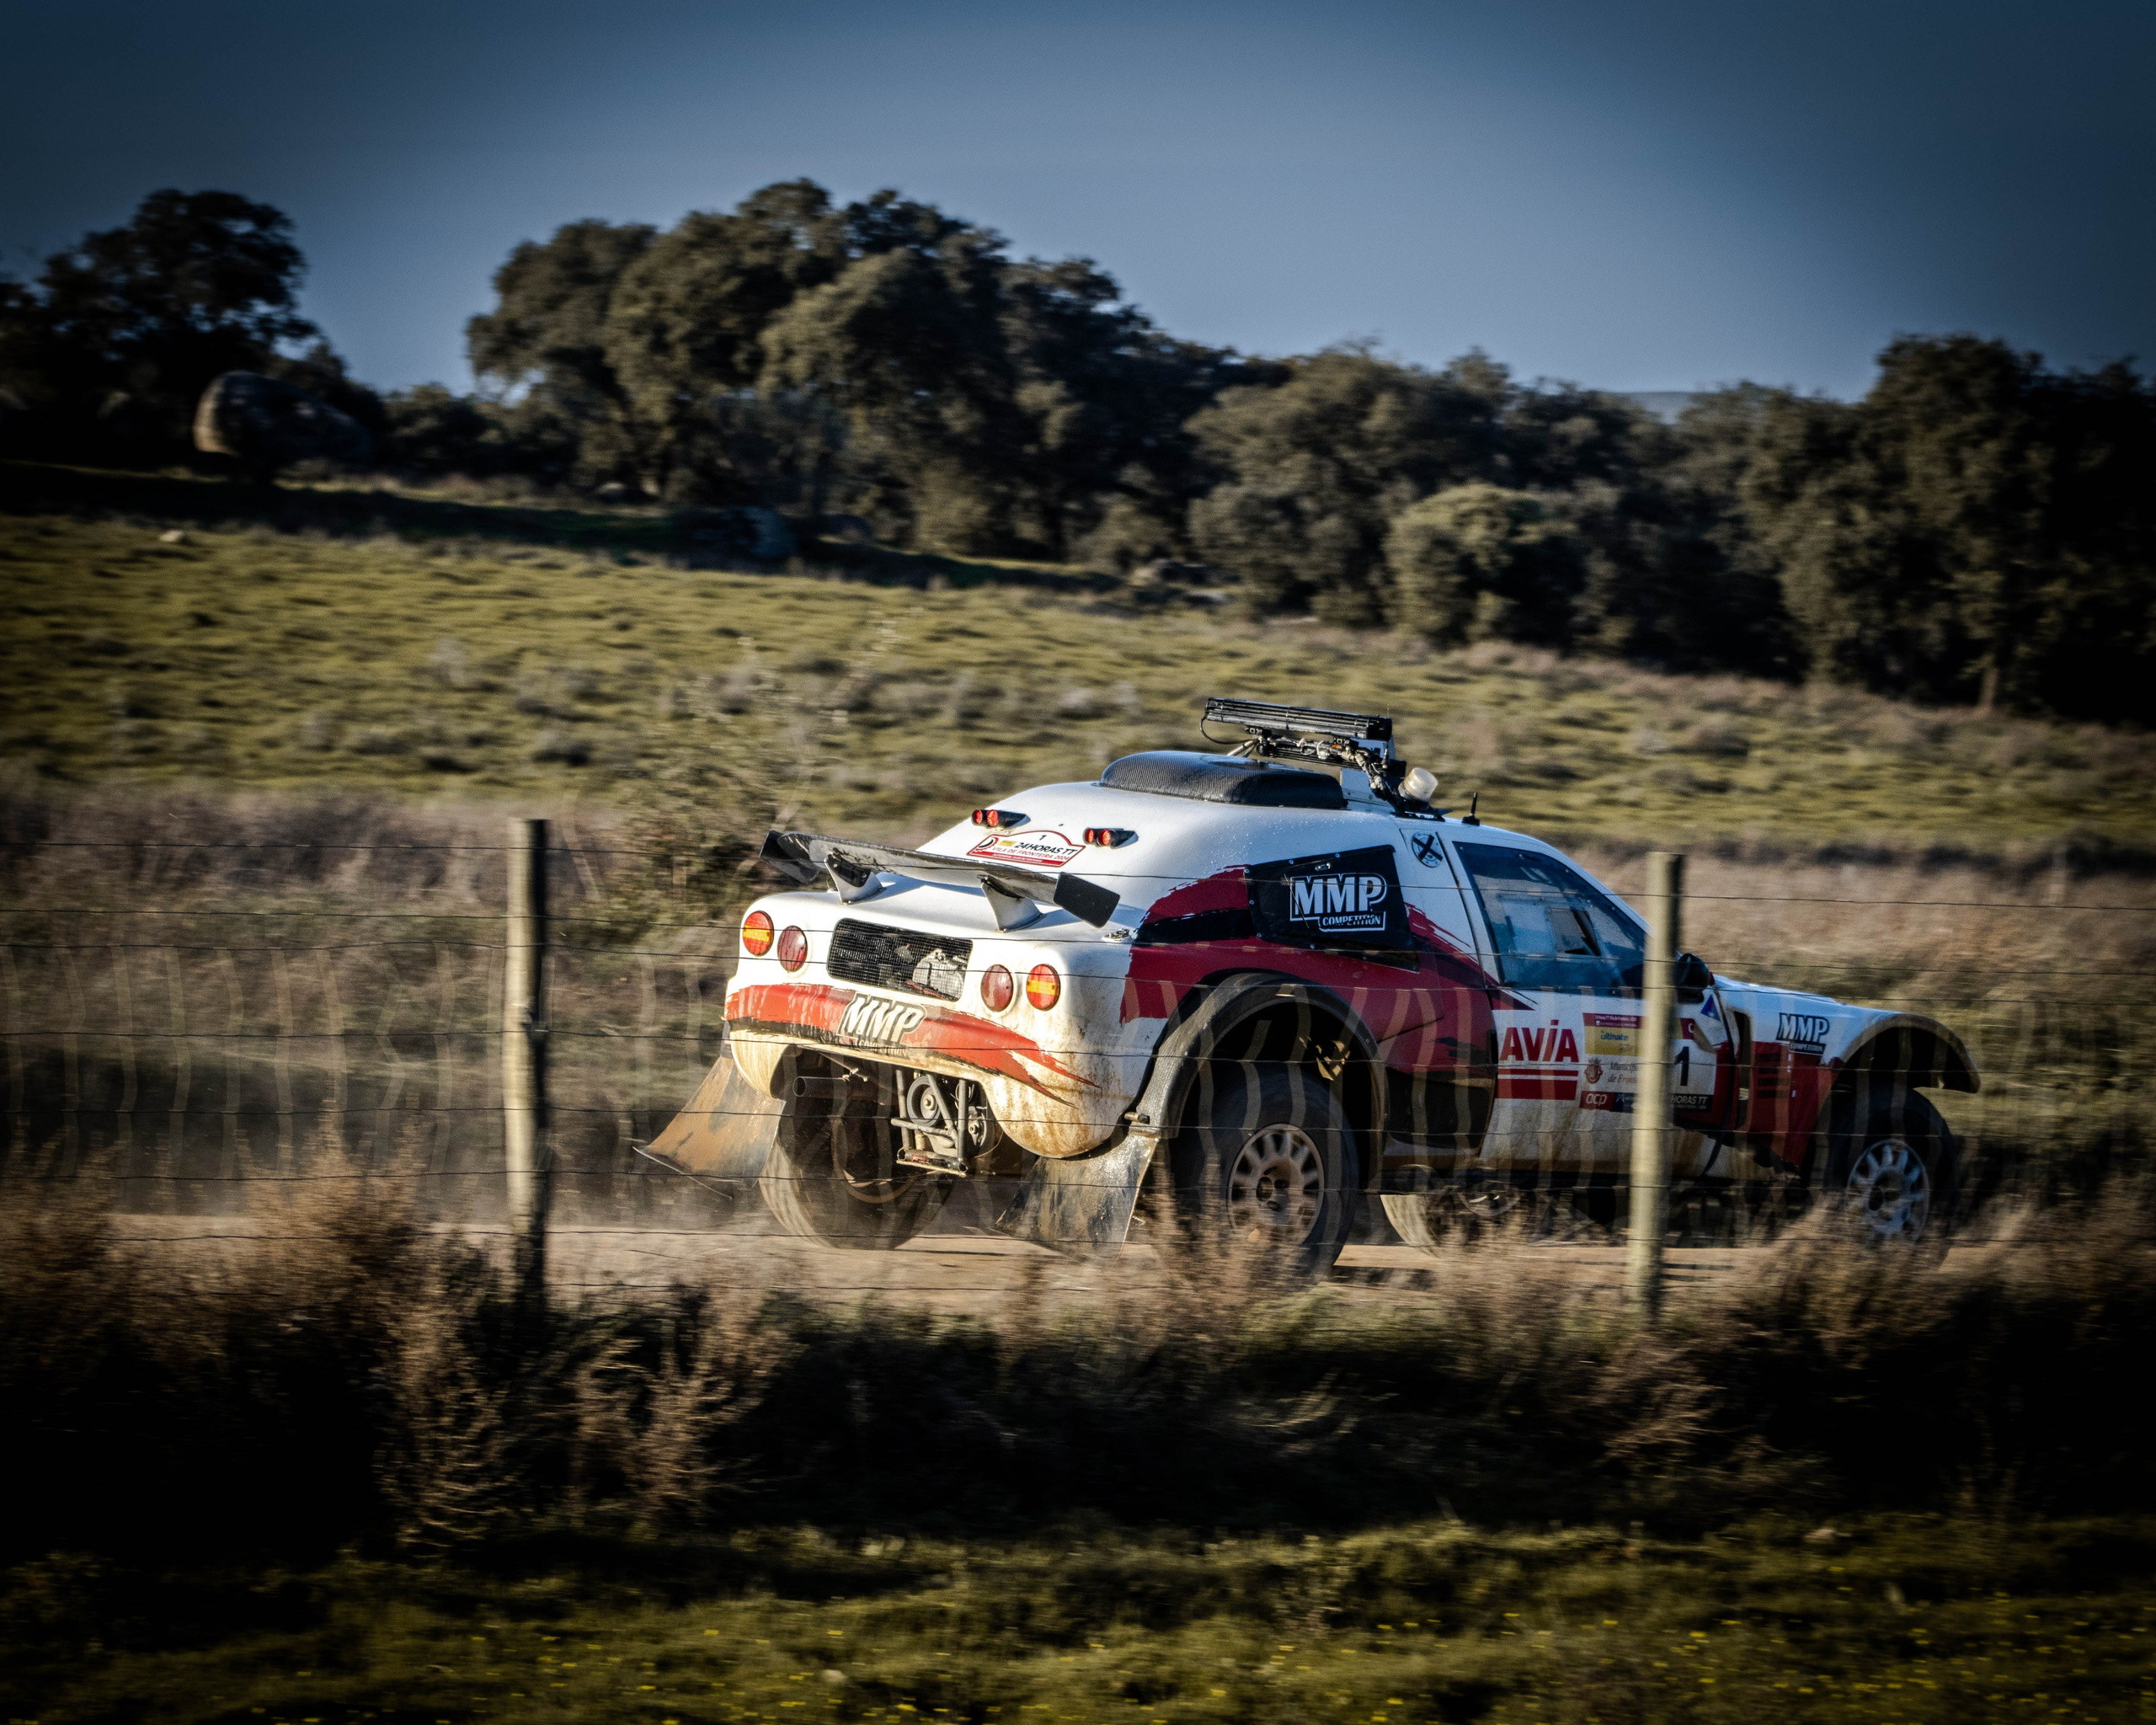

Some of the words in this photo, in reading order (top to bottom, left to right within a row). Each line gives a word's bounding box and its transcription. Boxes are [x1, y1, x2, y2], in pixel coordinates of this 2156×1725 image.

[1017, 850, 1054, 859] FRONTEIRA
[1294, 876, 1382, 916] MMP
[1322, 915, 1381, 927] COMPETITION
[841, 996, 924, 1043] MMP
[1777, 1014, 1828, 1043] MMP
[1673, 1046, 1690, 1087] 1
[1697, 1097, 1709, 1105] TT
